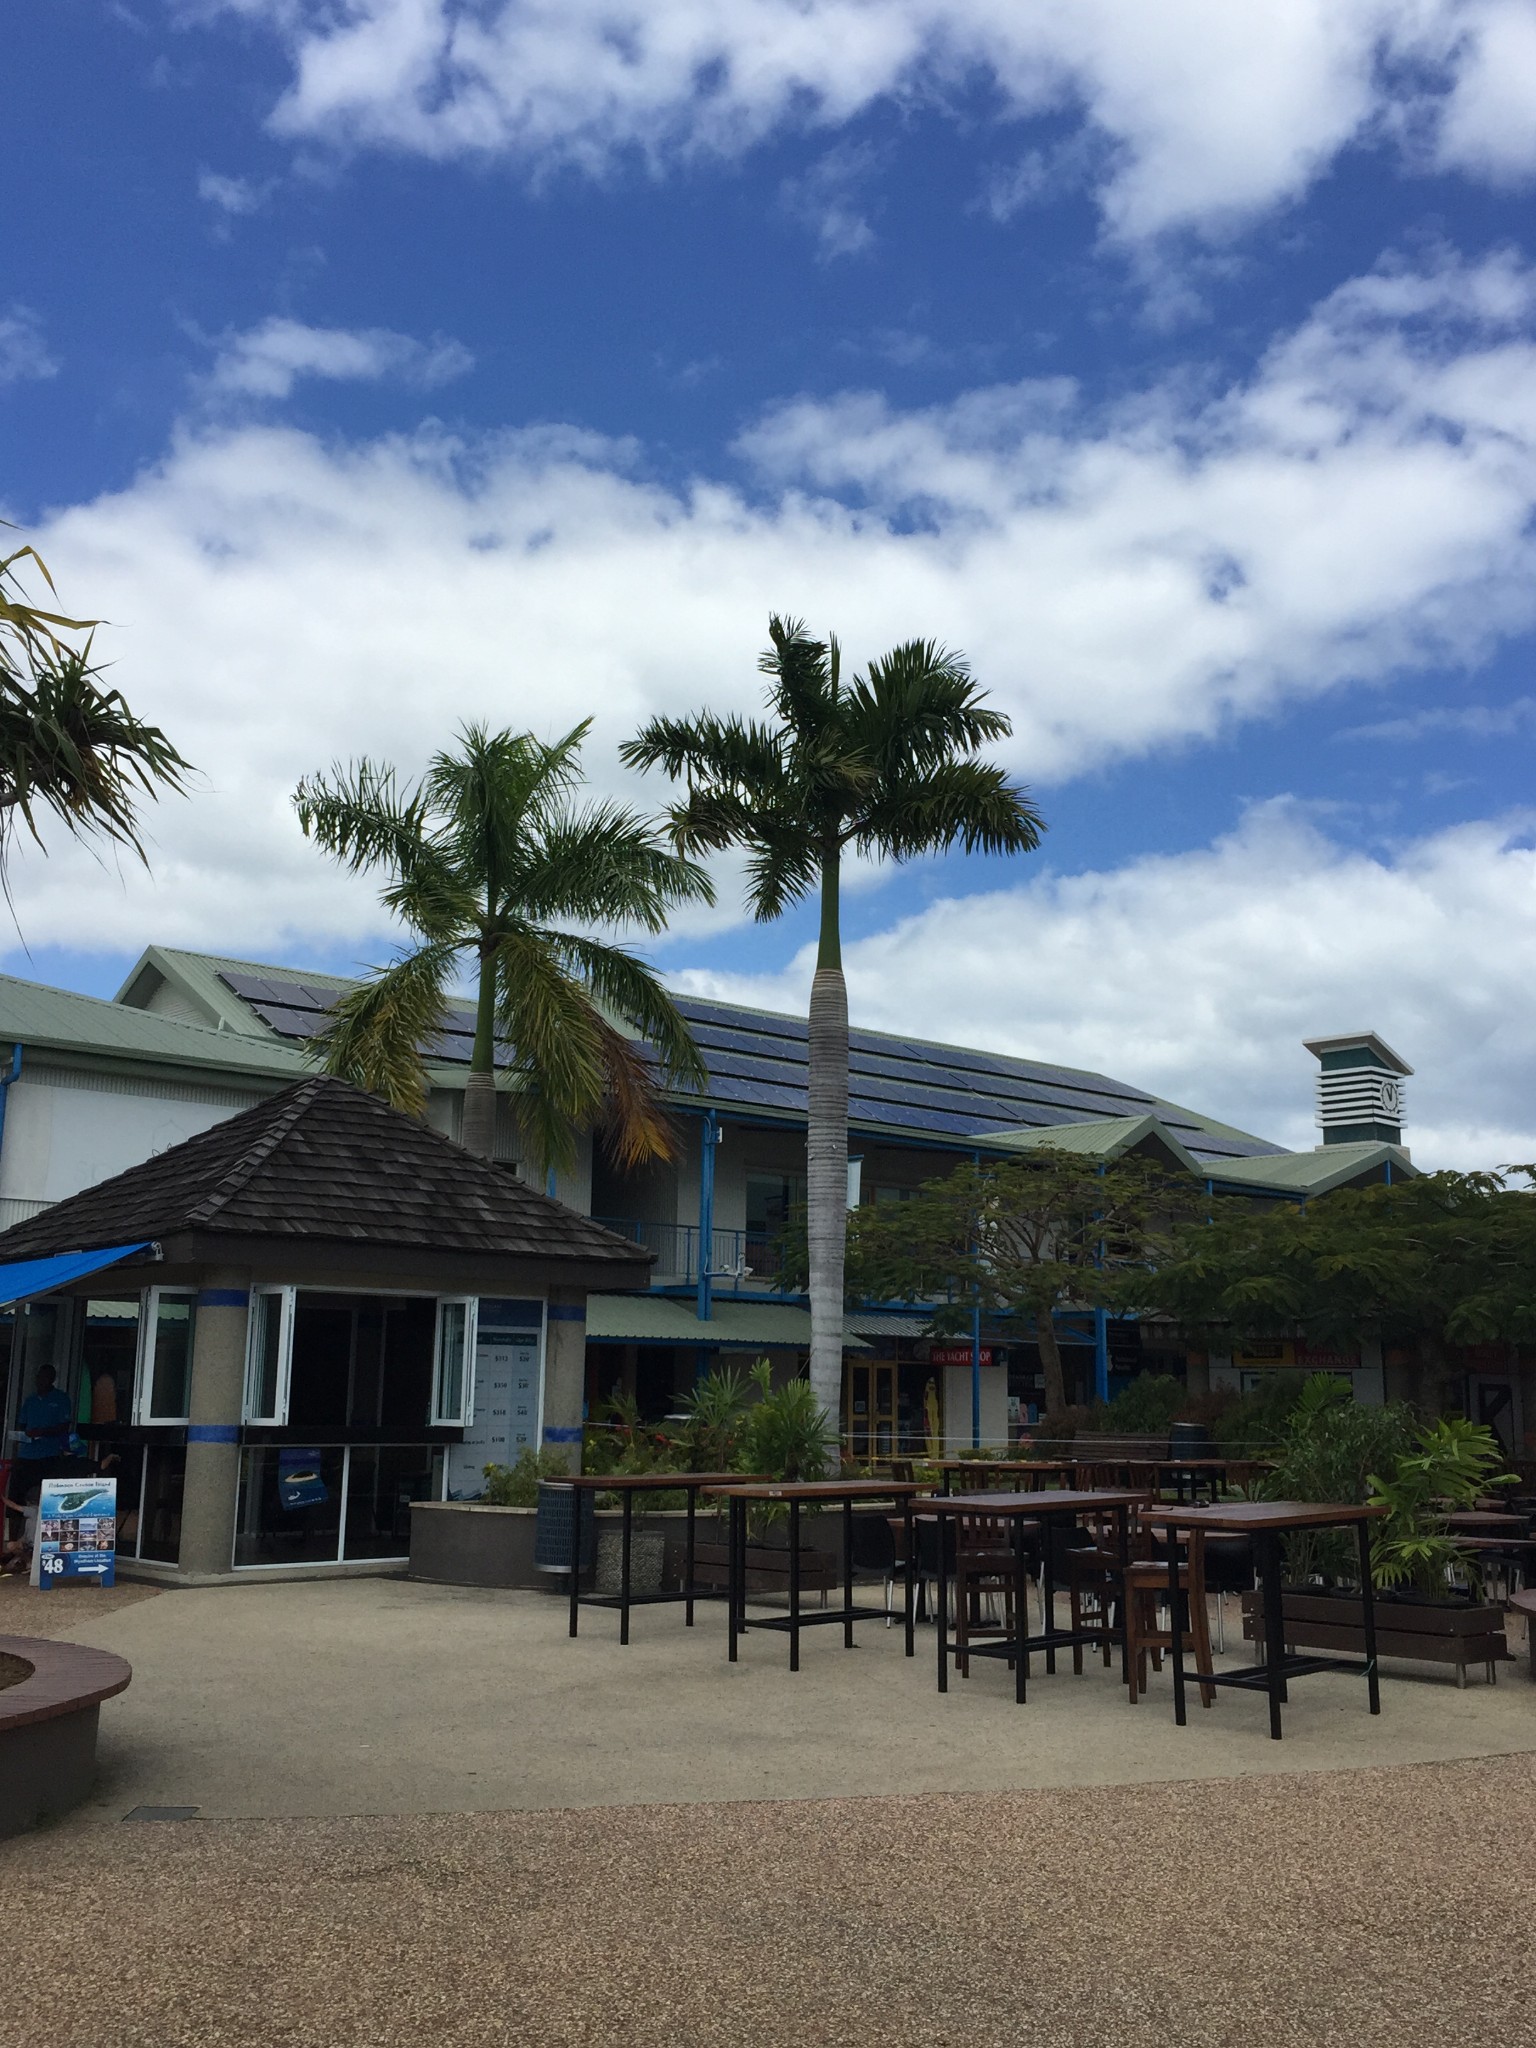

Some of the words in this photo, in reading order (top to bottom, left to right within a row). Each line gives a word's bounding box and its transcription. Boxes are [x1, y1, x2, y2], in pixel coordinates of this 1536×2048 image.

[932, 1351, 946, 1362] THE
[947, 1351, 969, 1362] YACHT
[970, 1351, 991, 1362] SOP
[1296, 1354, 1358, 1365] EXCHANGE
